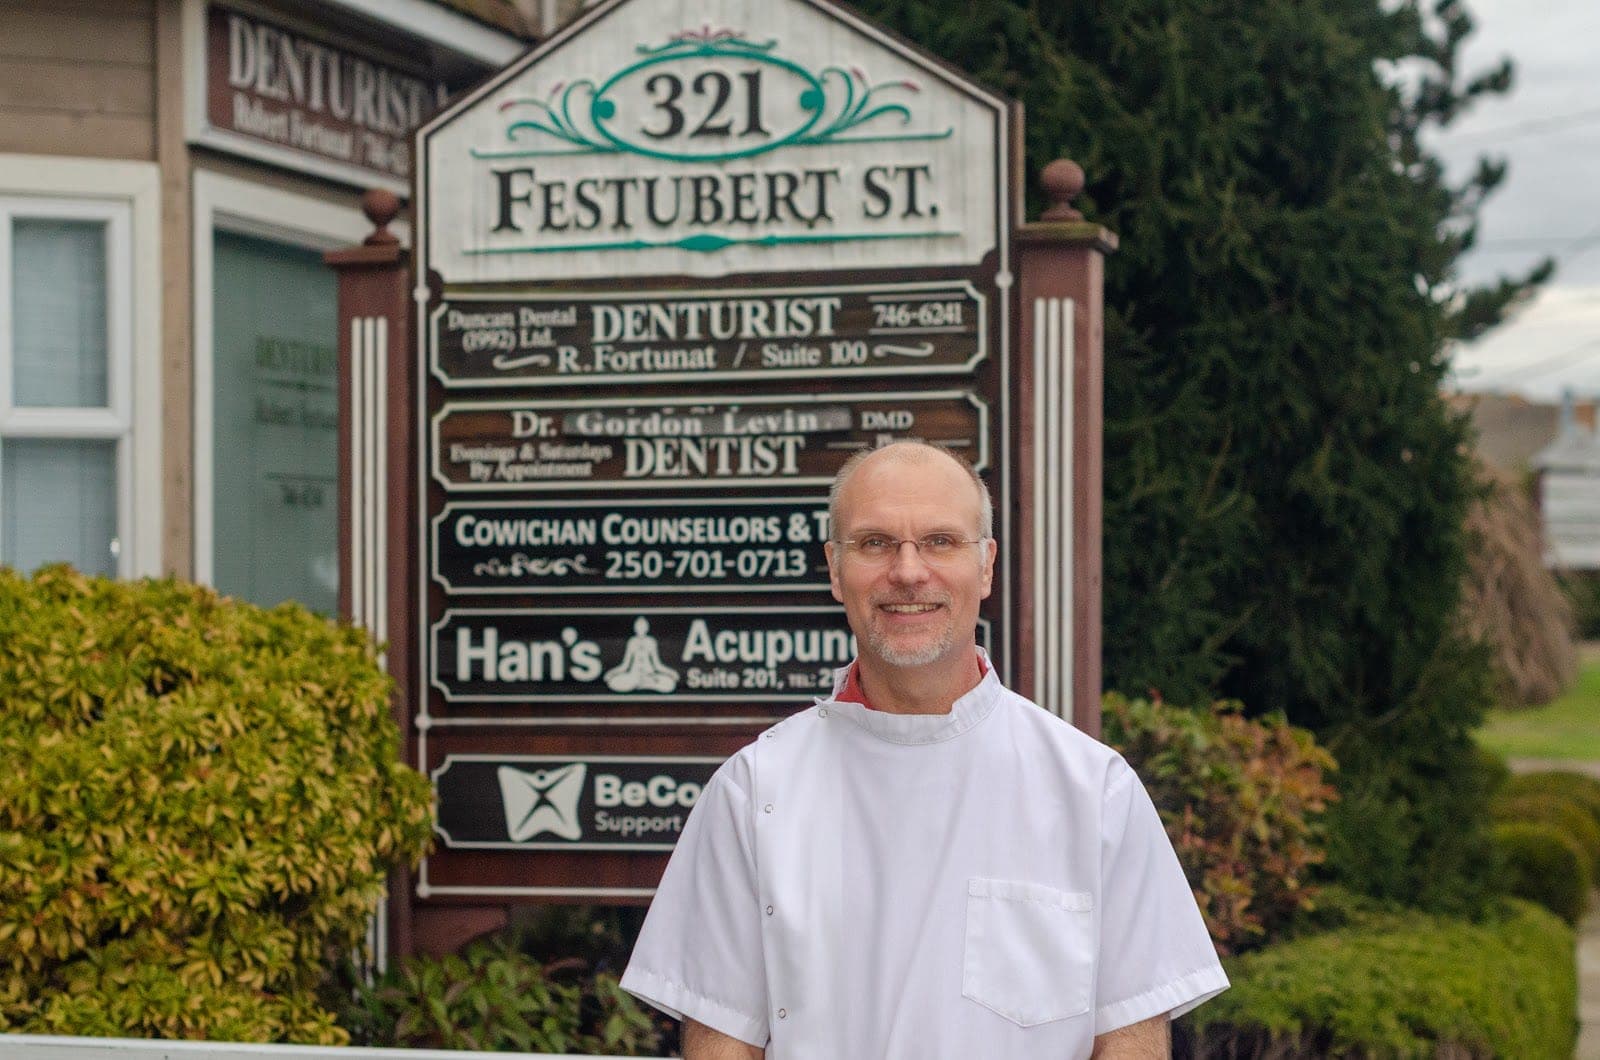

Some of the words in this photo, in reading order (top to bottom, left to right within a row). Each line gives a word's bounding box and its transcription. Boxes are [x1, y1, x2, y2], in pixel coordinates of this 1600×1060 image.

[229, 16, 421, 137] DENTURIST
[641, 69, 772, 140] 321
[490, 167, 840, 233] FESTUBERT
[862, 165, 939, 220] ST.
[448, 309, 515, 330] Duncan
[519, 306, 577, 326] Dental
[592, 297, 841, 343] DENTURIST
[872, 303, 962, 327] 746-6241
[598, 345, 717, 372] Fortunat
[732, 342, 748, 369] /
[762, 342, 822, 367] Suite
[829, 341, 868, 365] 100
[512, 410, 557, 438] Dr.
[576, 411, 702, 437] Gordon
[723, 408, 819, 435] Levin
[861, 410, 915, 431] DMD
[519, 443, 535, 461] &
[624, 435, 806, 477] DENTIST
[455, 514, 597, 547] COWICHAN
[601, 513, 780, 545] COUNSELLORS
[787, 511, 812, 543] &
[812, 510, 832, 543] T
[605, 549, 807, 579] 250-701-0713
[456, 627, 602, 682] Han's
[686, 667, 740, 689] Suite
[742, 667, 784, 691] 201,
[594, 774, 704, 808] BeCo
[594, 810, 682, 838] Support
